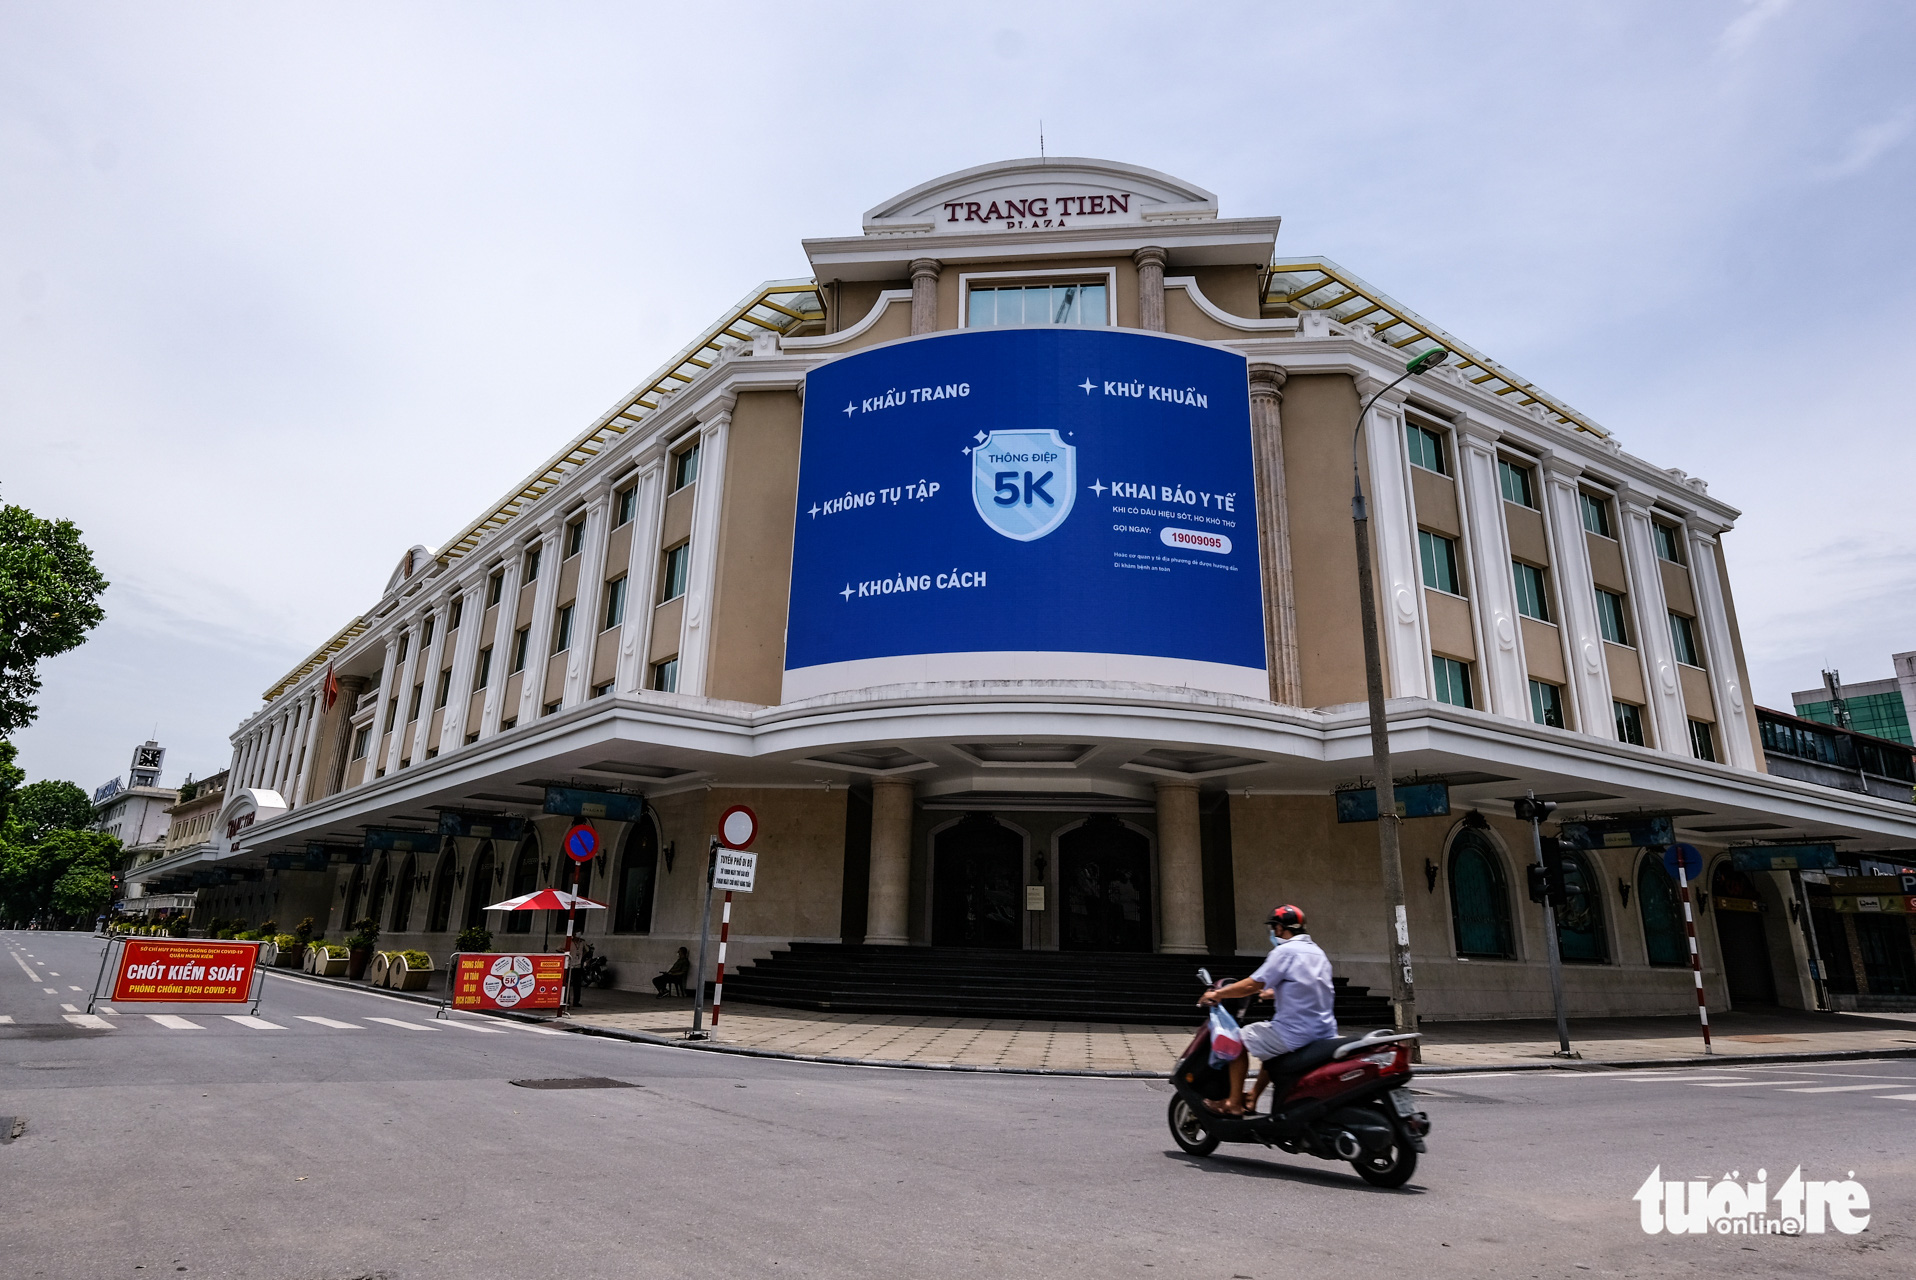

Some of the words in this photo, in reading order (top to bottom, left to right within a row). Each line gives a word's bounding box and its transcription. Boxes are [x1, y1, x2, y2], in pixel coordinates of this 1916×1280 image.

[944, 198, 1049, 223] TRANG
[1055, 194, 1131, 216] TIEN
[862, 387, 906, 413] KHẨU
[910, 383, 970, 403] TRANG
[1104, 379, 1145, 398] KHỬ
[1149, 387, 1208, 408] KHUẨN
[988, 452, 1029, 463] THÔNG
[1031, 452, 1058, 464] ĐIỆP
[823, 491, 875, 515] KHÔNG
[879, 486, 901, 505] TỤ
[905, 479, 940, 502] TẬP
[993, 471, 1055, 507] 5K
[1111, 481, 1156, 500] KHAI
[1161, 484, 1196, 505] BÁO
[1200, 491, 1210, 507] Y
[1214, 492, 1236, 512] TẾ
[1128, 526, 1152, 534] NGAY:
[1171, 532, 1222, 548] 19009095
[858, 572, 931, 597] KHOẢNG
[936, 567, 986, 589] CÁCH
[126, 959, 166, 980] CHỐT
[167, 960, 205, 981] KIỂM
[207, 964, 245, 982] SOÁT
[505, 977, 516, 985] 5K
[157, 983, 183, 994] CHỐNG
[204, 985, 237, 995] COVID-19
